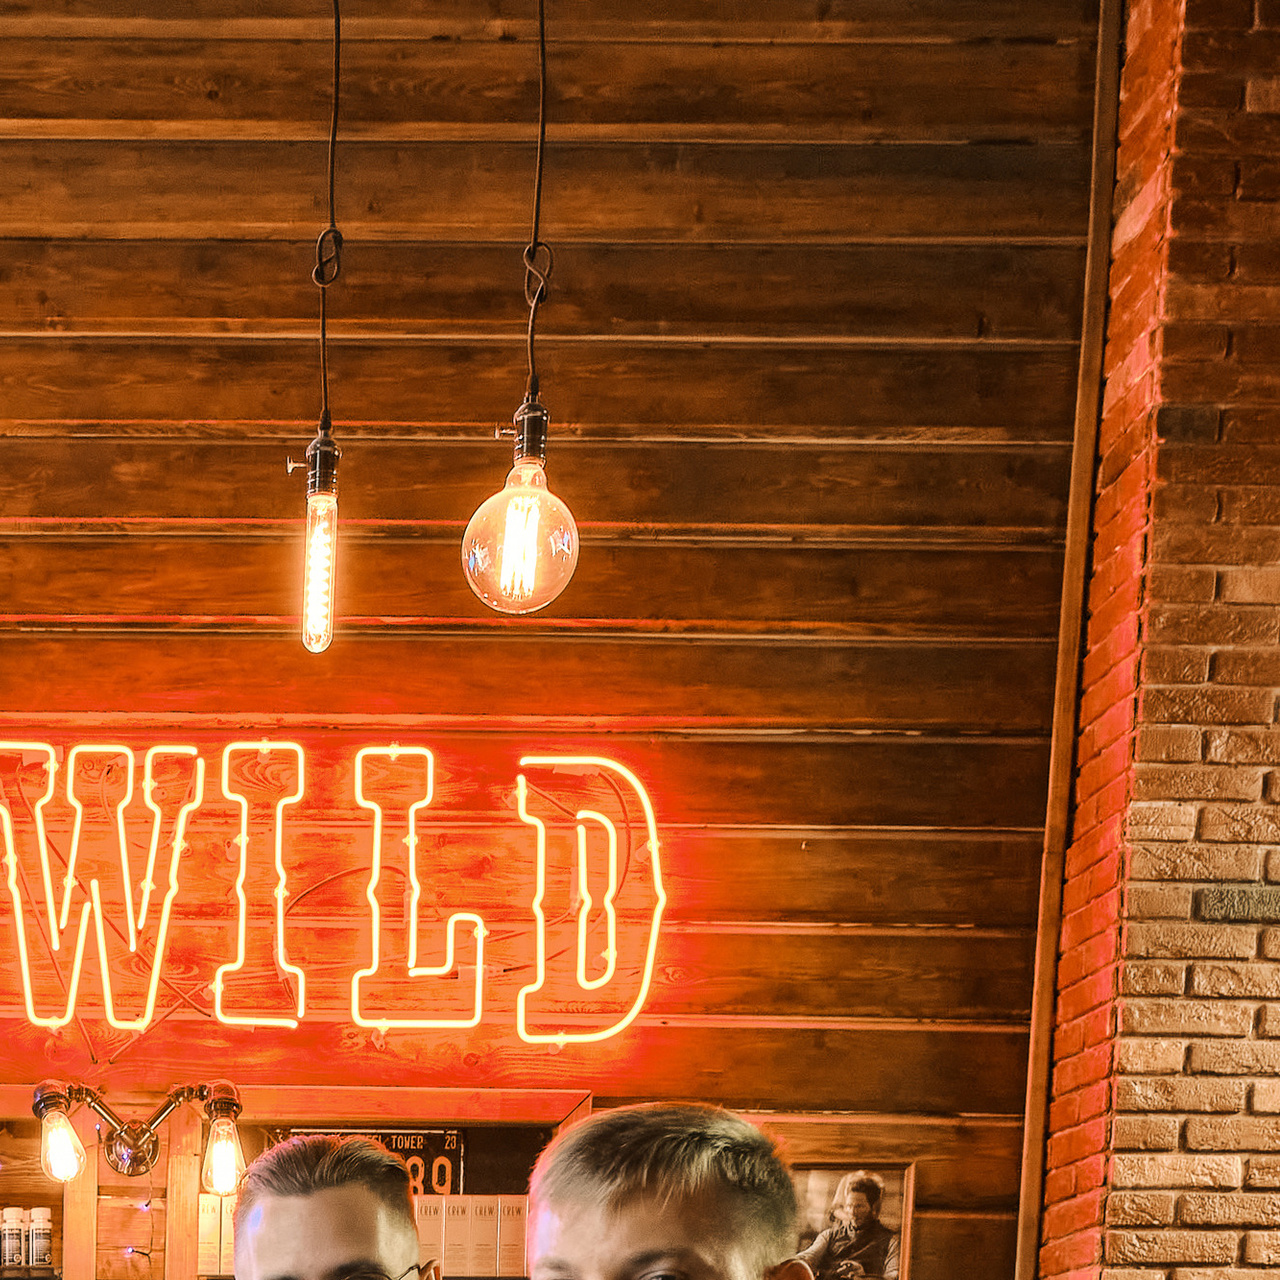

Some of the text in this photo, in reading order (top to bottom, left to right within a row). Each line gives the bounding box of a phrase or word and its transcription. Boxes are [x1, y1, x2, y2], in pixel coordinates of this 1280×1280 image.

[391, 1135, 423, 1150] TOWER
[444, 1135, 457, 1149] 23
[420, 1205, 439, 1216] CREW
[447, 1205, 467, 1216] CREW
[474, 1205, 495, 1216] CREW
[503, 1205, 522, 1216] CREW
